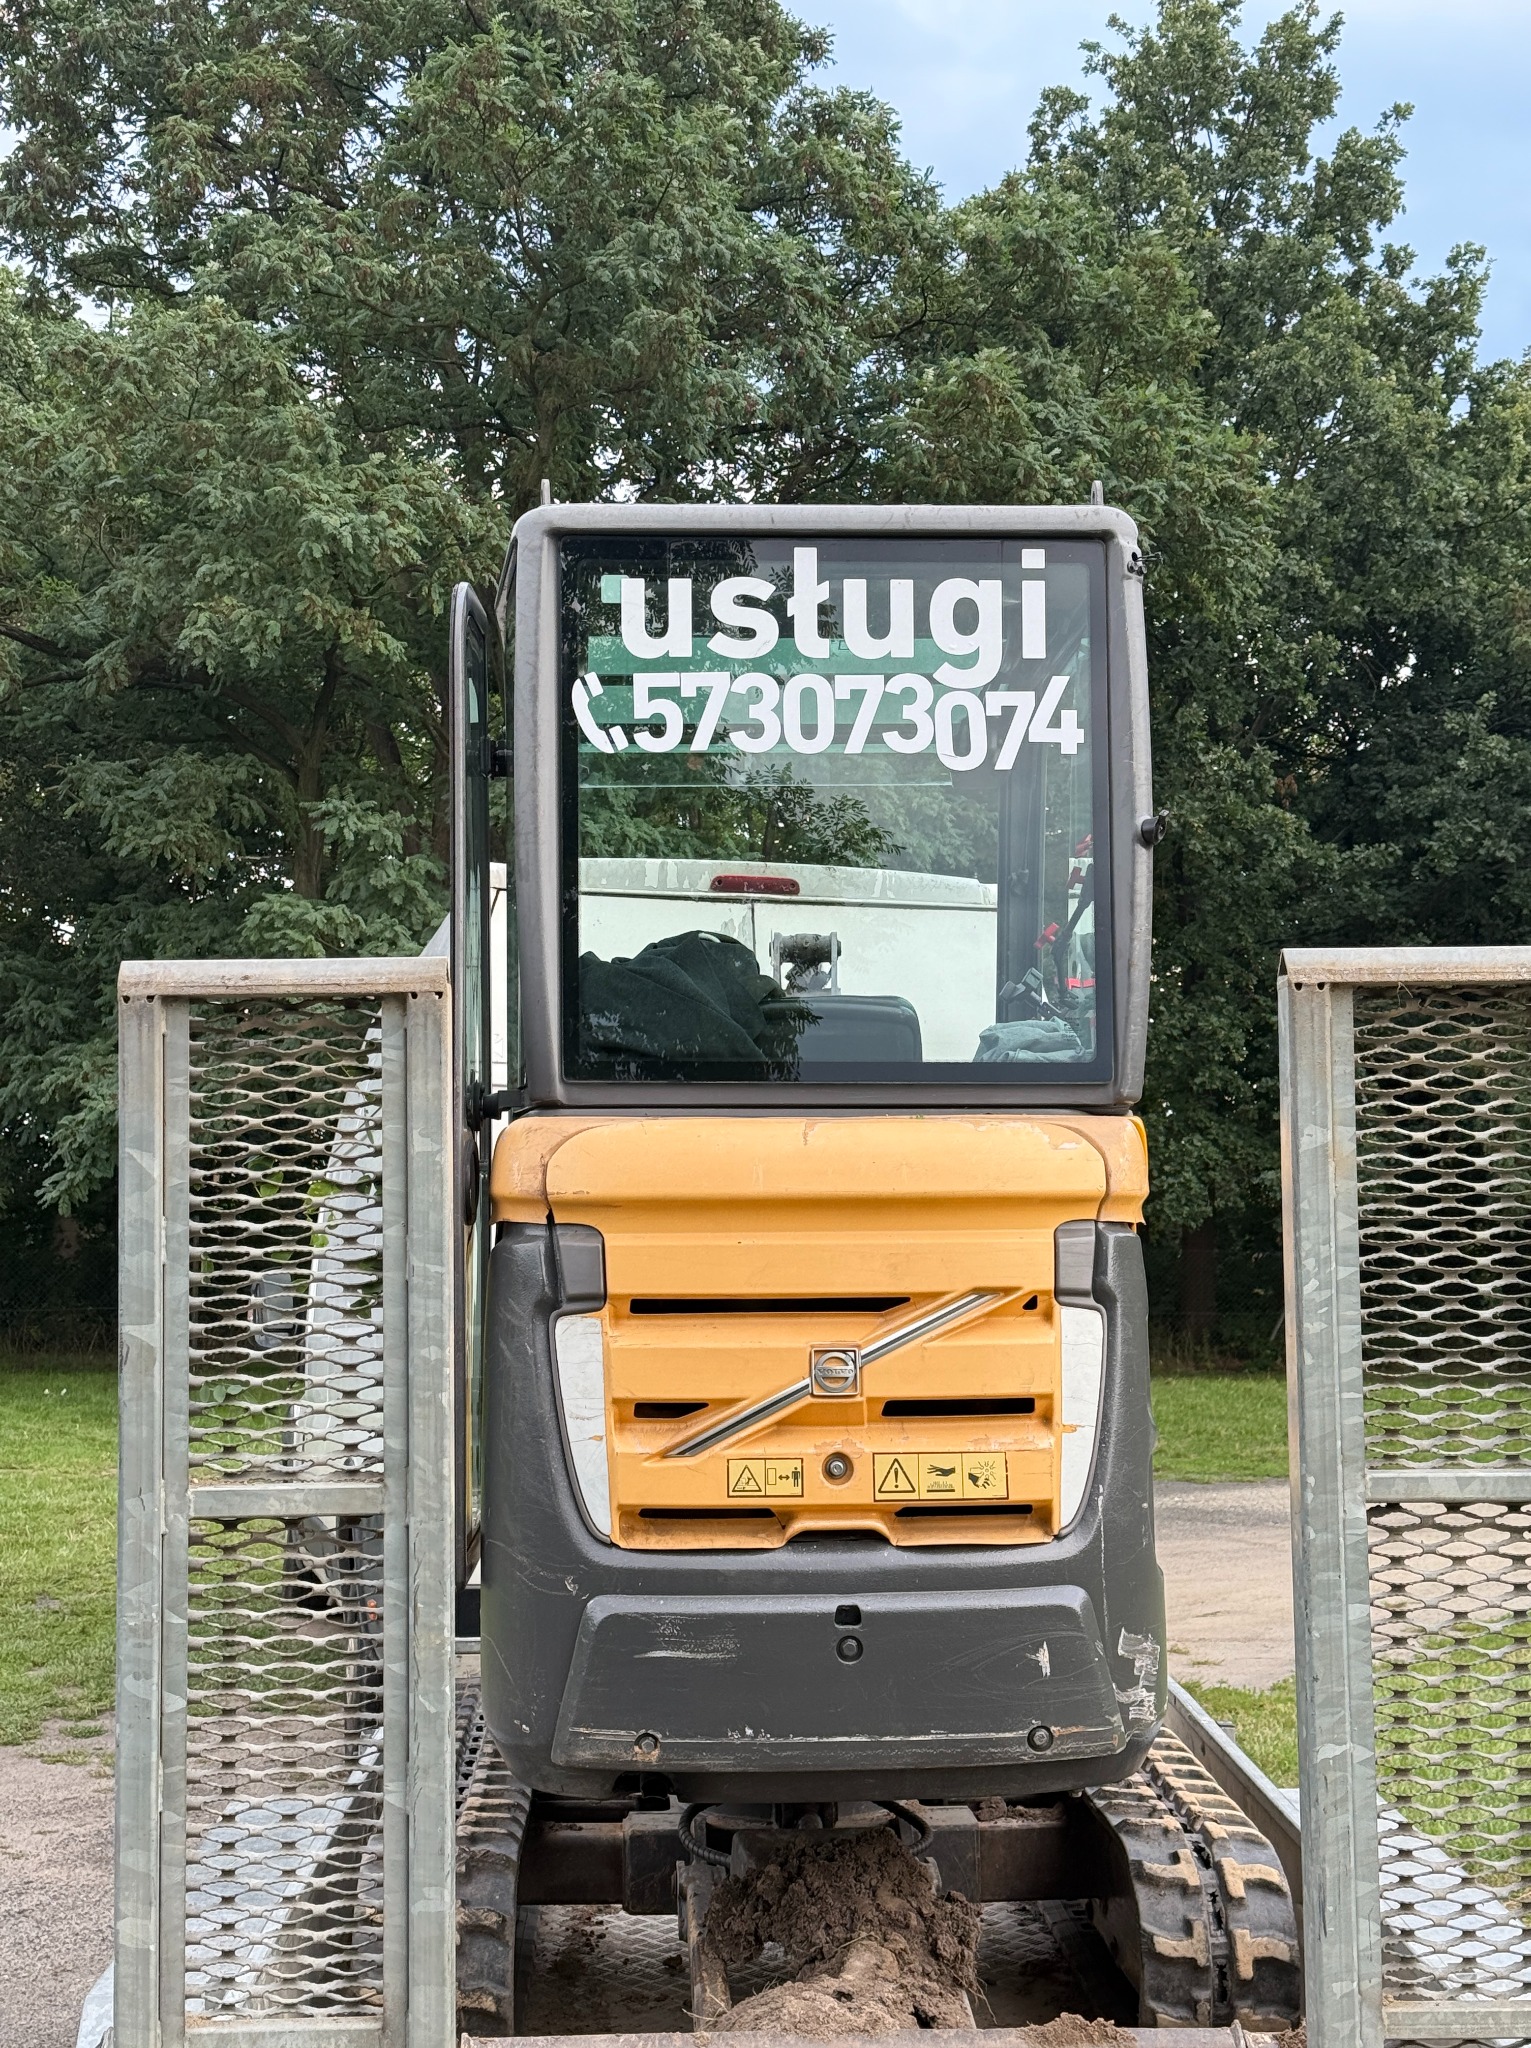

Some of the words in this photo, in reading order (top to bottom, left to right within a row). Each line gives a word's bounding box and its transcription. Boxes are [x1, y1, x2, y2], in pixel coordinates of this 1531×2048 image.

[621, 547, 1046, 688] usługi
[633, 672, 1084, 771] 573073074
[816, 1368, 854, 1376] VOLVO
